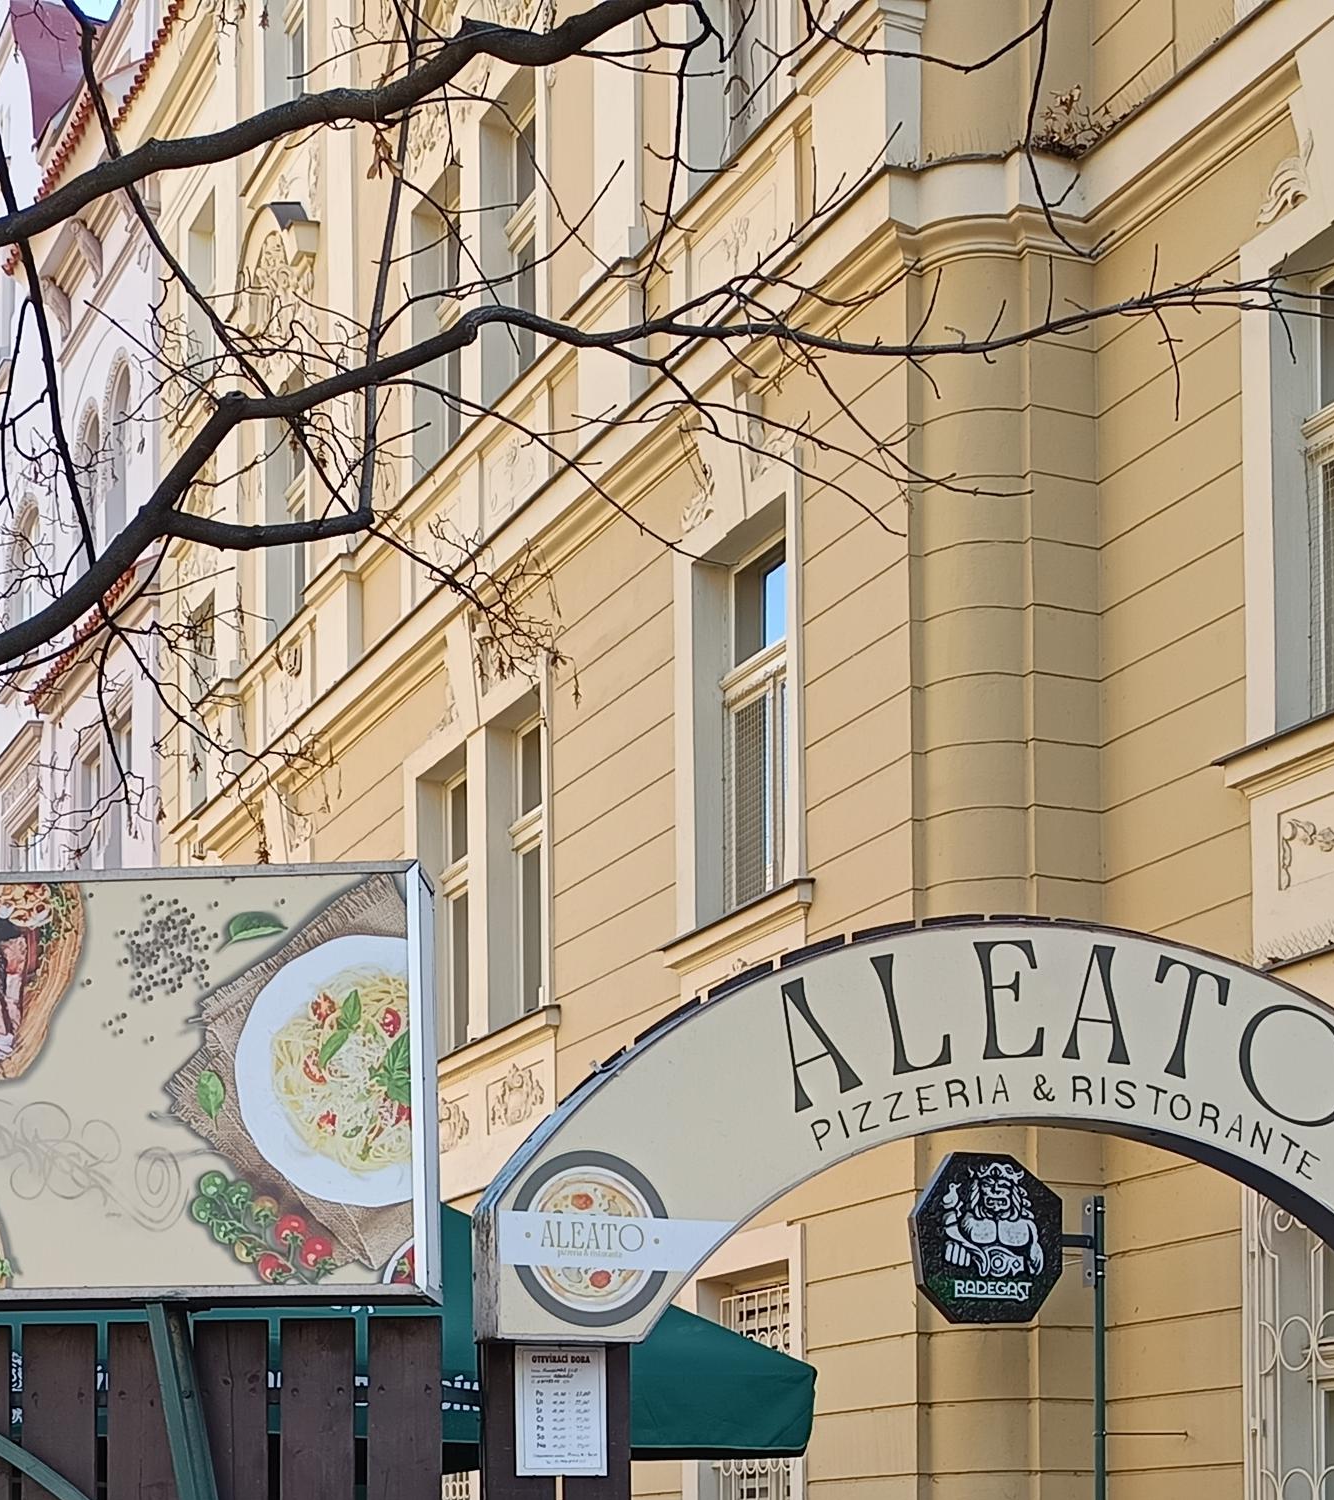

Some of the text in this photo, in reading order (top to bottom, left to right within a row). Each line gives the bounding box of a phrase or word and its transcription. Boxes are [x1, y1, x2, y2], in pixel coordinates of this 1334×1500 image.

[810, 1074, 1321, 1180] PIZZERIA & RISTORANTE
[540, 1219, 645, 1253] ALEATO
[954, 1280, 1033, 1302] RADEGAST
